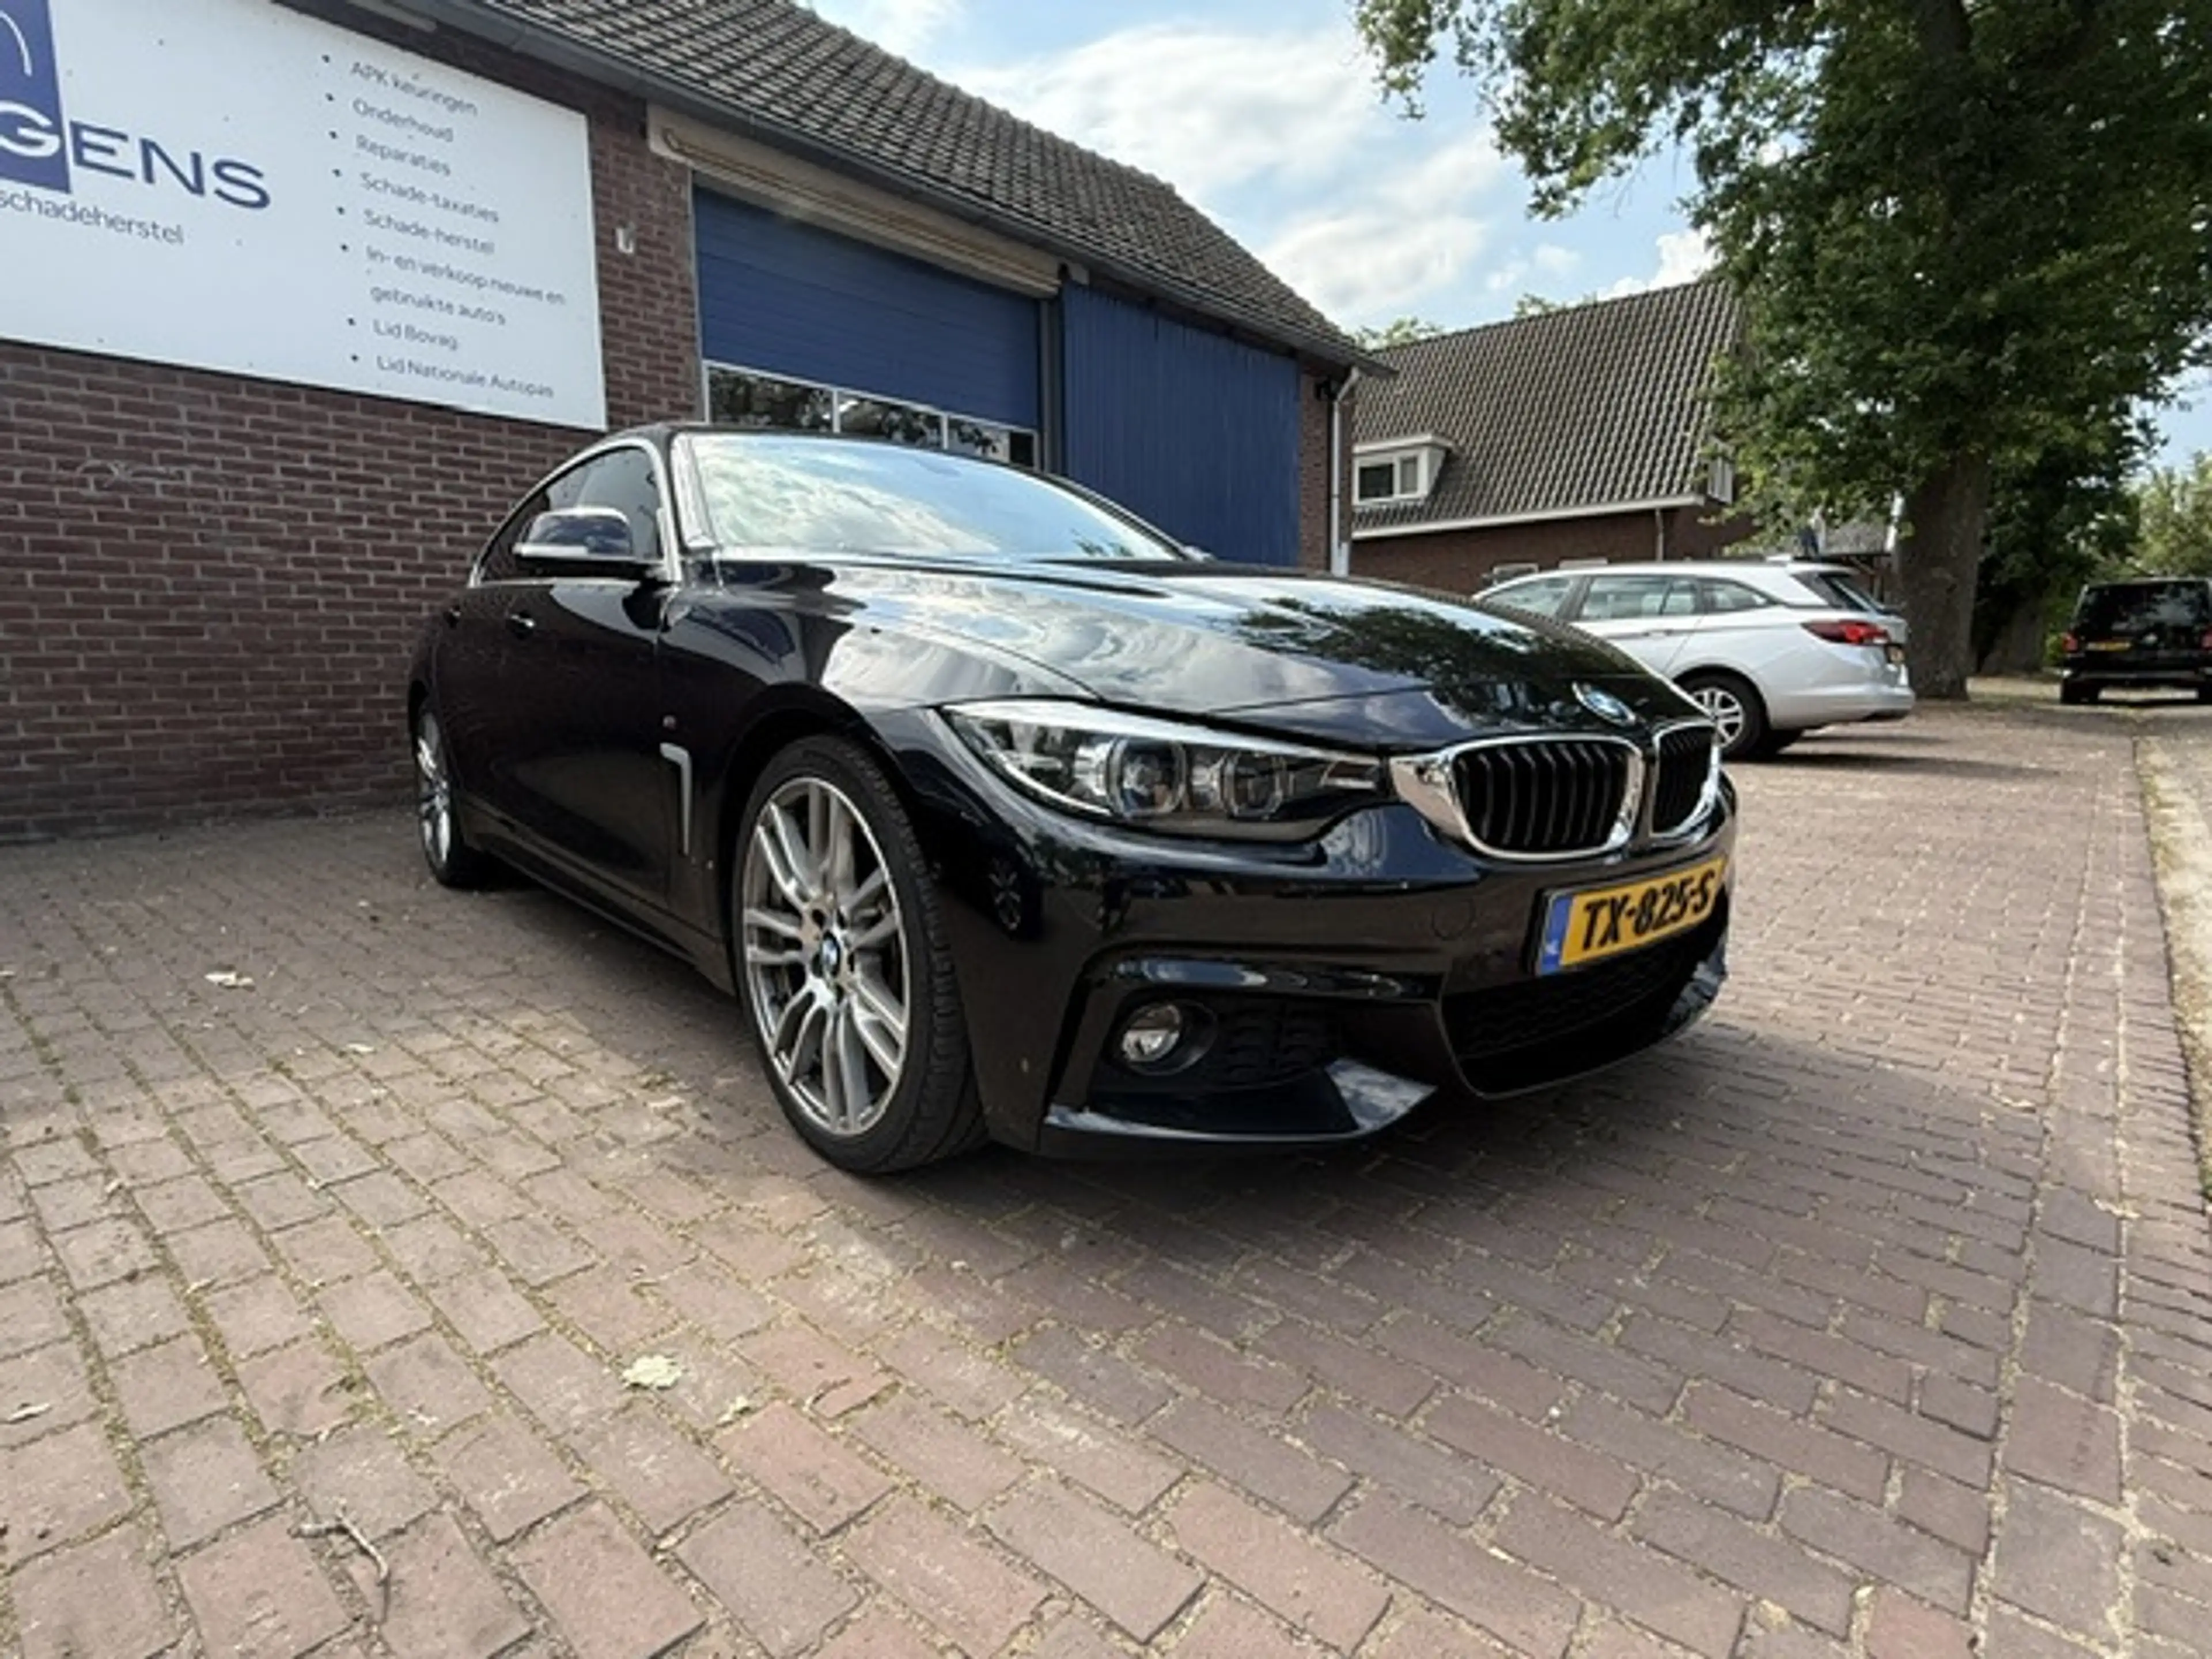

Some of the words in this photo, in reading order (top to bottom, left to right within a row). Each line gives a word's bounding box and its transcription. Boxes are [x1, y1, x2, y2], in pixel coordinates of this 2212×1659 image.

[353, 98, 454, 142] Onderhoud
[394, 255, 416, 271] en
[373, 319, 402, 339] Lid
[377, 355, 404, 374] Lid
[1582, 869, 1715, 950] TX-825-S
